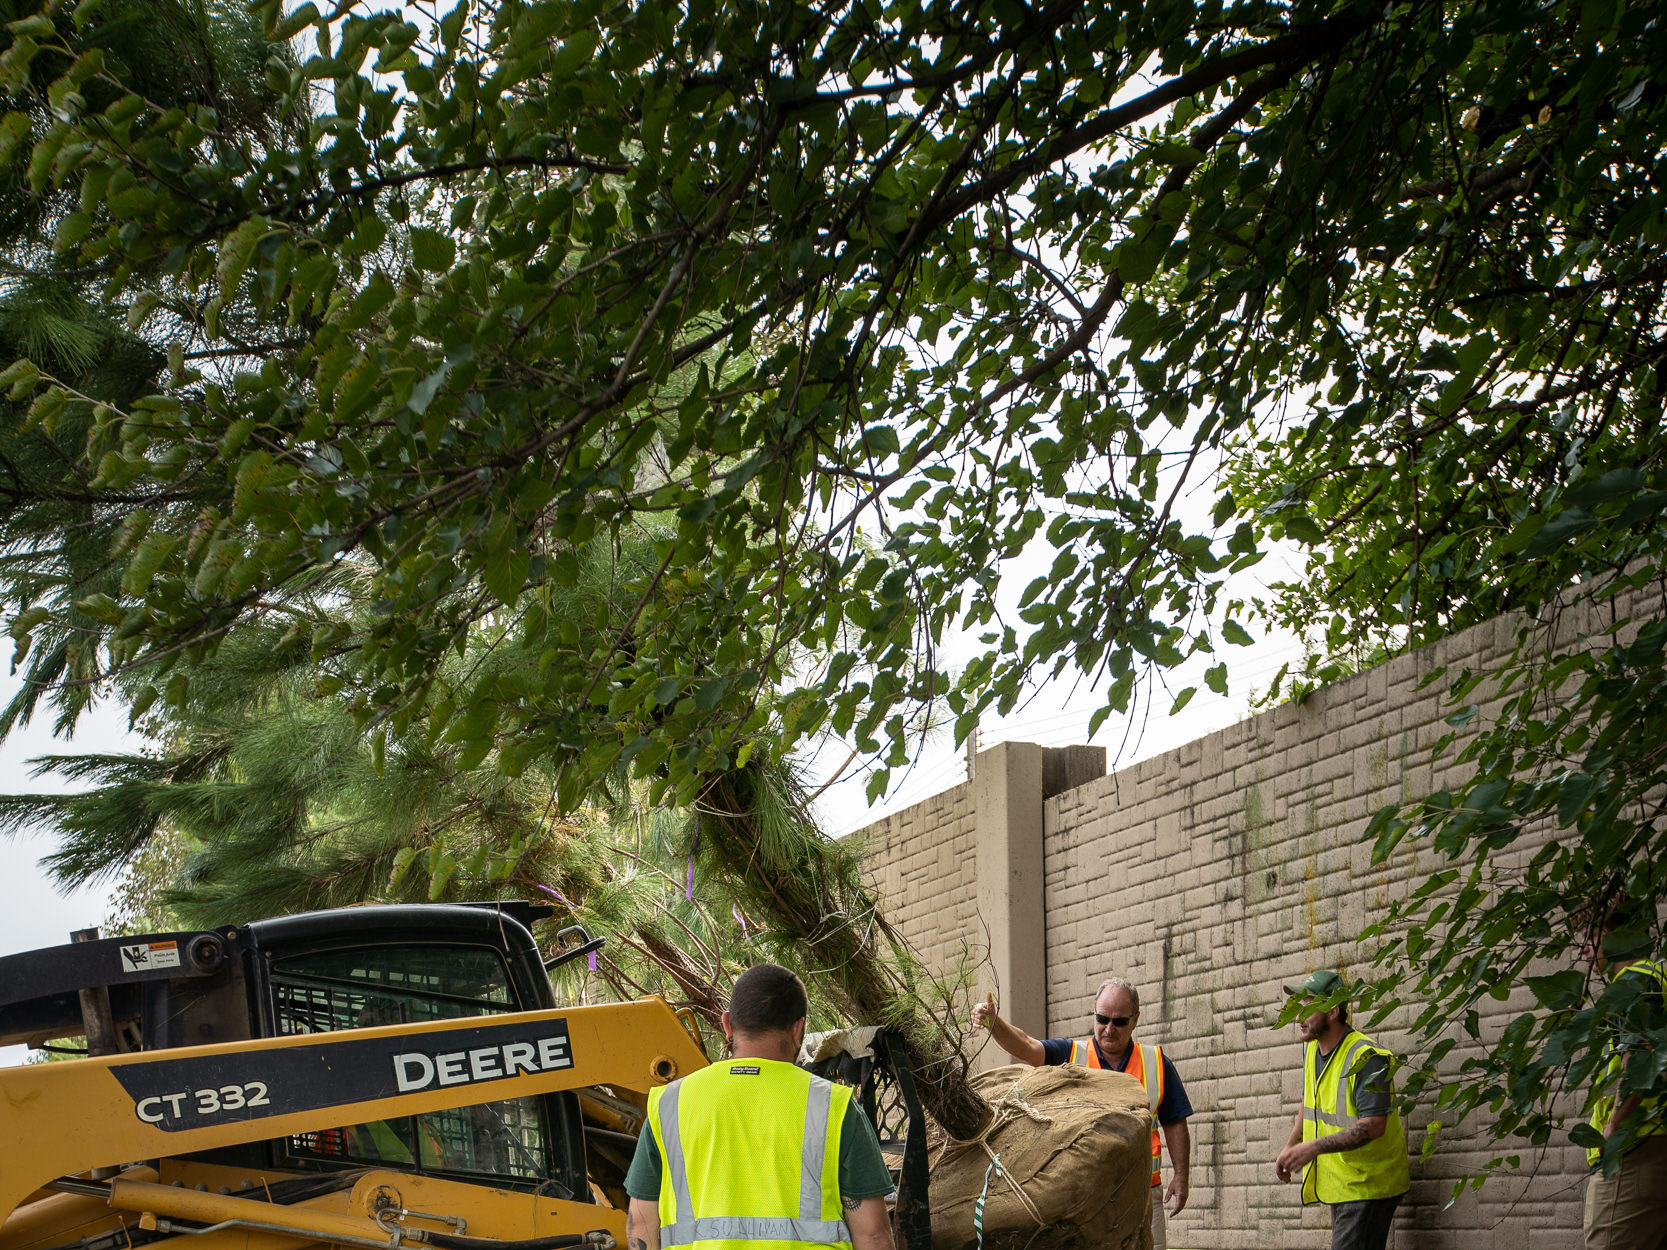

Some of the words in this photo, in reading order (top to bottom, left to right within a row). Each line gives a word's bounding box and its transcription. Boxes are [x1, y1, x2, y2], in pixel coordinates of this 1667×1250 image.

[393, 1036, 571, 1092] DEERE
[137, 1093, 187, 1123] CT
[195, 1081, 270, 1114] 332
